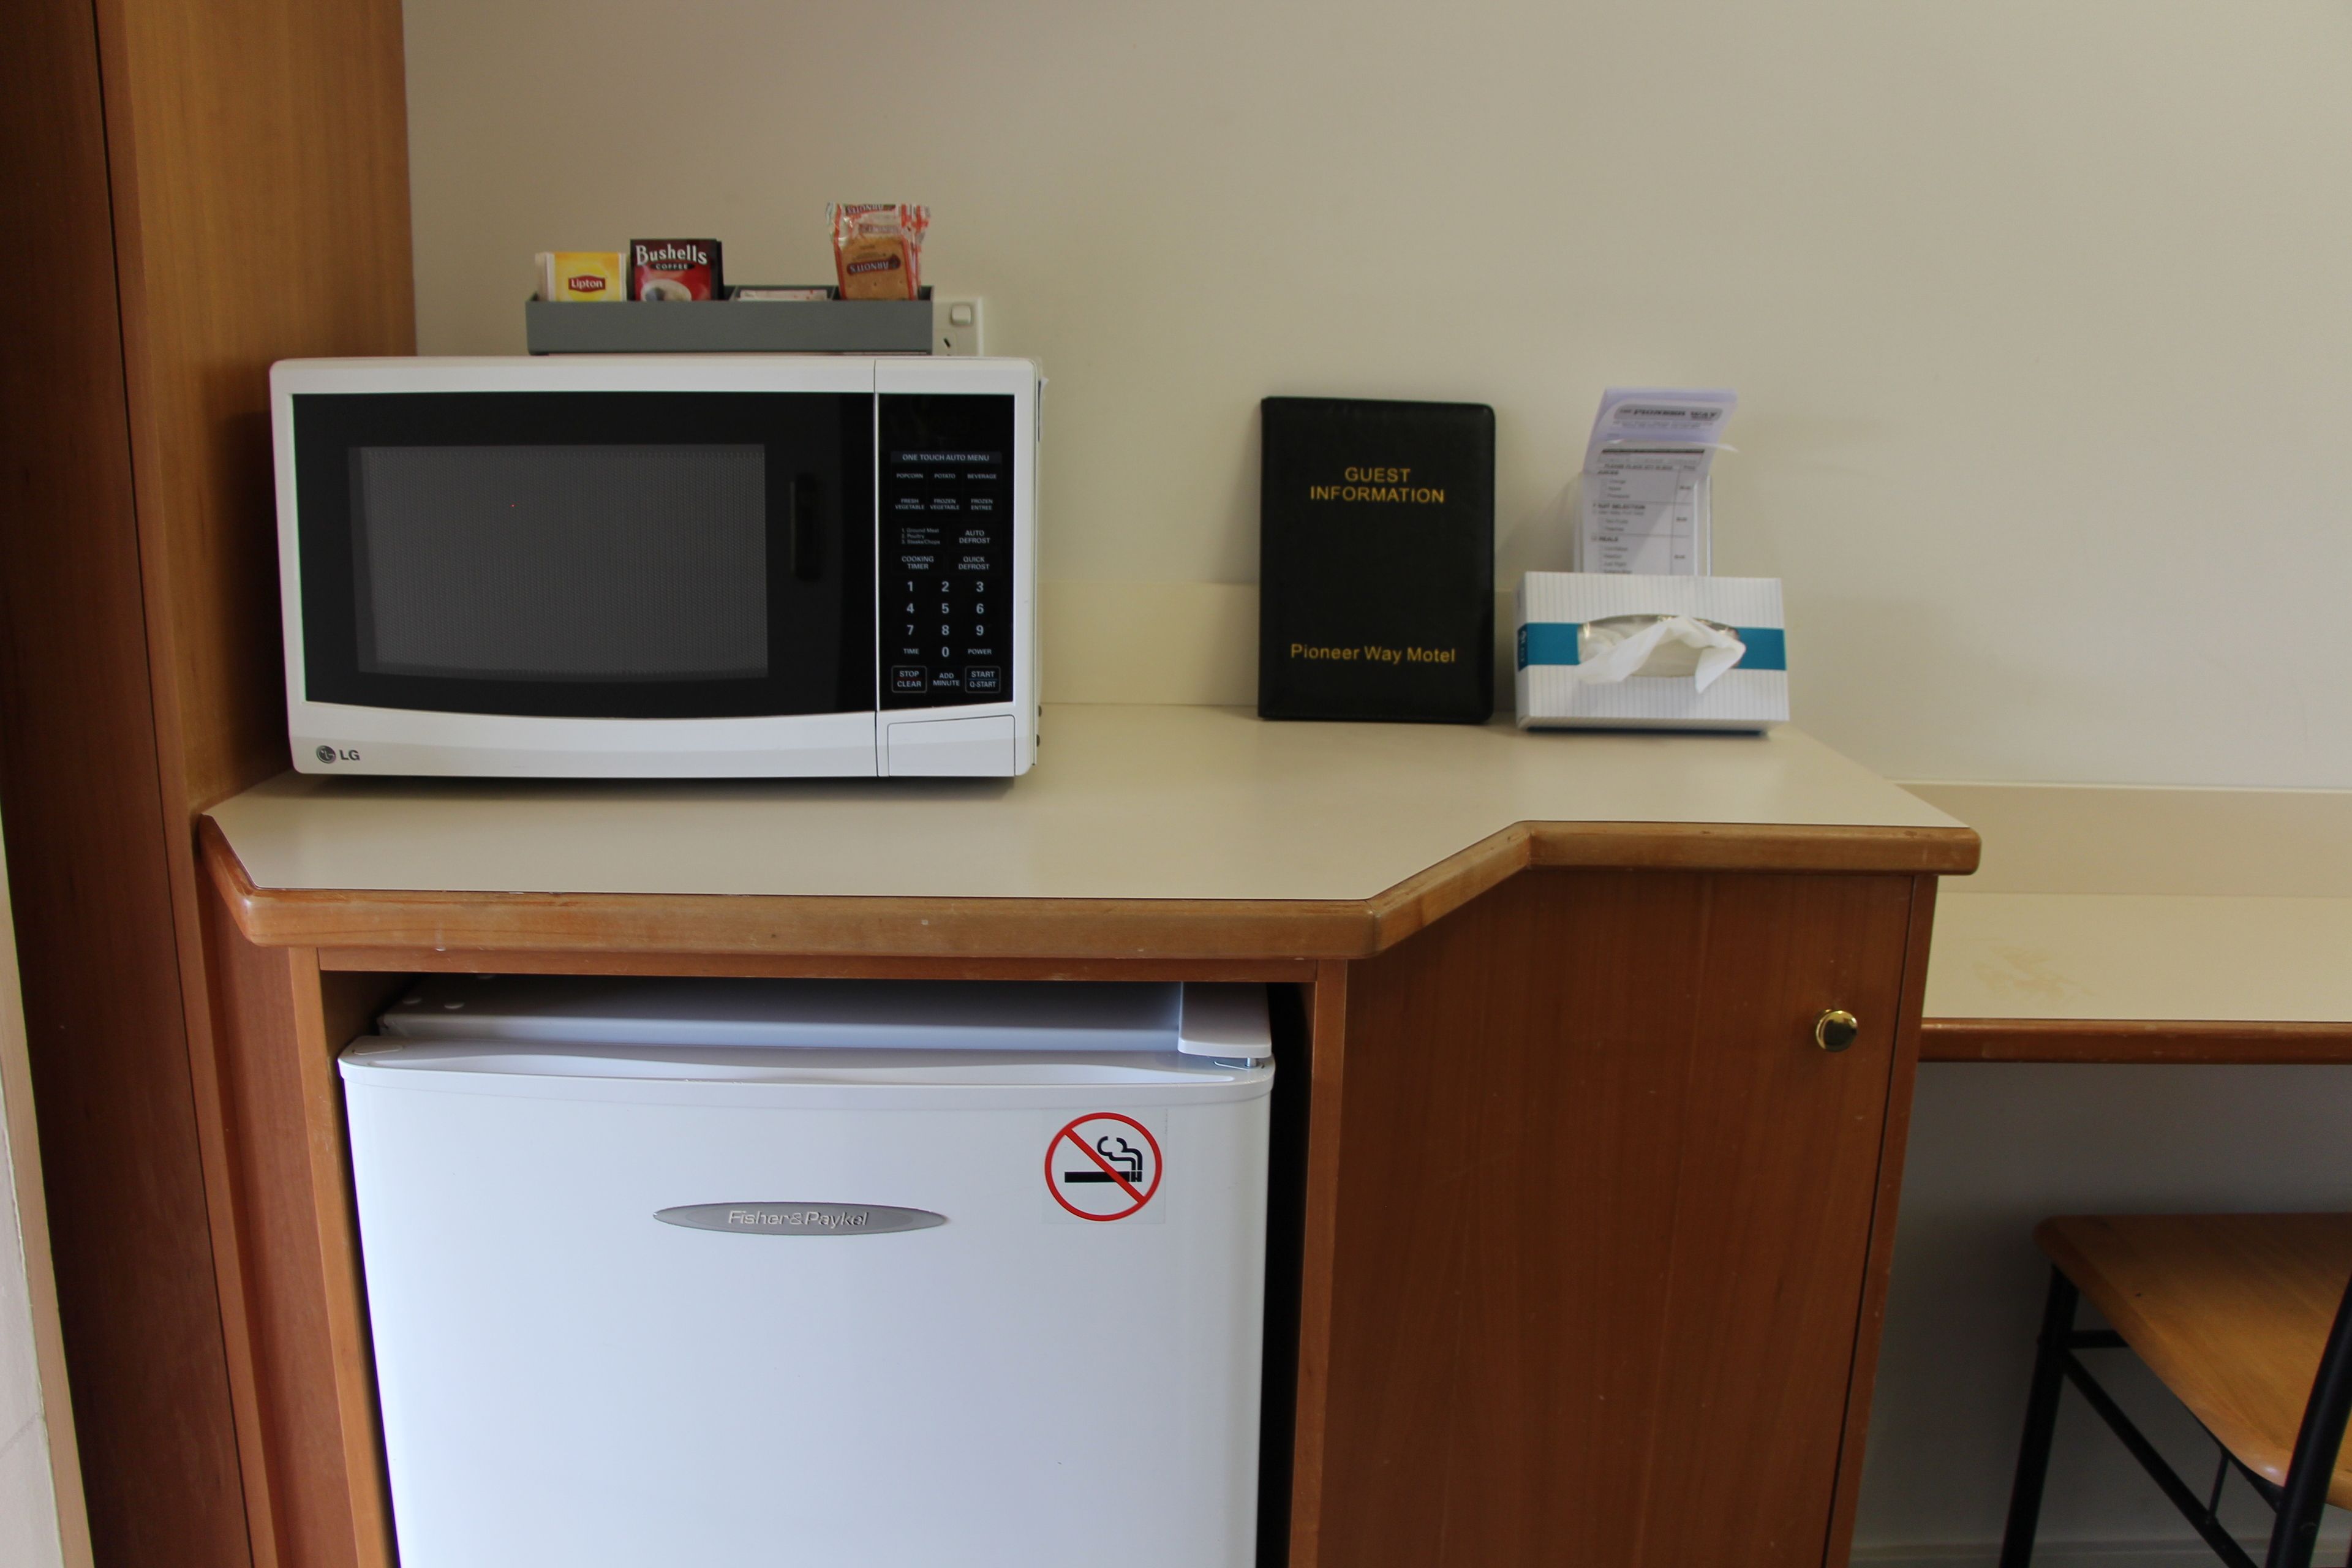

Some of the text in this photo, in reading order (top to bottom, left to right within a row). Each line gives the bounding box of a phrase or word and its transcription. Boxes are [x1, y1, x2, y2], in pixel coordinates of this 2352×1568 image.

[636, 243, 708, 266] Bushells
[570, 278, 603, 290] Lipton
[1344, 466, 1411, 483] GUEST
[1310, 485, 1445, 504] INFORMATION
[907, 581, 913, 592] 1
[941, 581, 949, 592] 2
[976, 582, 984, 592] 3
[907, 603, 914, 613] 4
[941, 603, 949, 614] 5
[976, 603, 984, 614] 6
[907, 625, 914, 635] 7
[941, 625, 949, 635] 8
[976, 625, 984, 636] 9
[942, 647, 949, 657] 0
[1291, 643, 1455, 665] Pioneer Way Motel
[339, 749, 360, 761] LG
